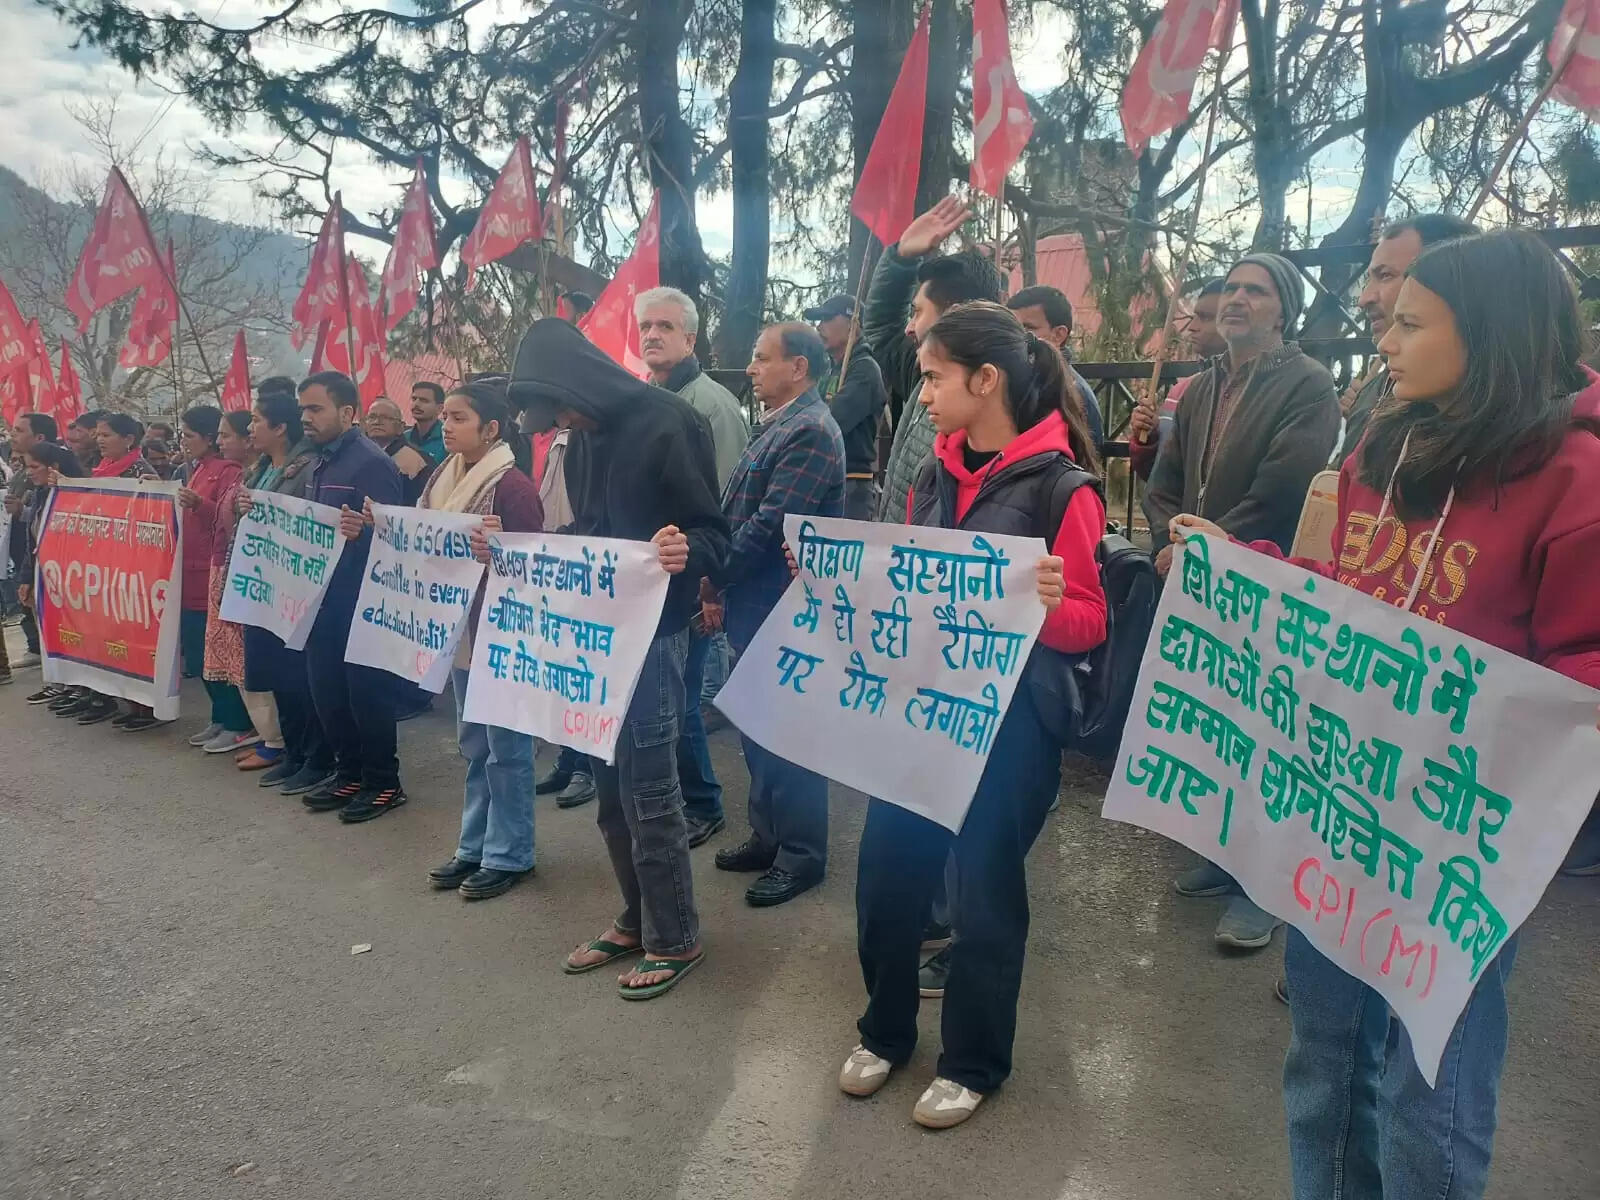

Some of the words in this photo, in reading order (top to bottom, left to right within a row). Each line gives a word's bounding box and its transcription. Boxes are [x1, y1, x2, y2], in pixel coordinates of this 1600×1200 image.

[64, 560, 150, 630] CPI(M)
[303, 553, 330, 586] नहीं
[414, 568, 424, 600] in
[429, 582, 470, 610] every
[531, 543, 596, 598] संस्थानों
[597, 548, 619, 599] में
[799, 520, 865, 582] शिक्षण
[887, 535, 1010, 604] संस्थानों
[1339, 510, 1479, 606] BOSS
[793, 581, 823, 634] में
[870, 595, 913, 659] रही
[1181, 533, 1270, 633] शिक्षण
[1275, 577, 1441, 716] संस्थानों
[1431, 644, 1488, 734] में
[488, 642, 511, 679] पर
[512, 640, 539, 689] रोक
[775, 645, 824, 694] पर
[839, 649, 889, 719] रोक
[904, 681, 1001, 756] लगाओ
[1145, 680, 1257, 781] सम्मान
[1159, 614, 1263, 712] छात्राओं
[1260, 664, 1300, 743] की
[1307, 702, 1404, 802] सुरक्षा
[1412, 743, 1513, 865] और
